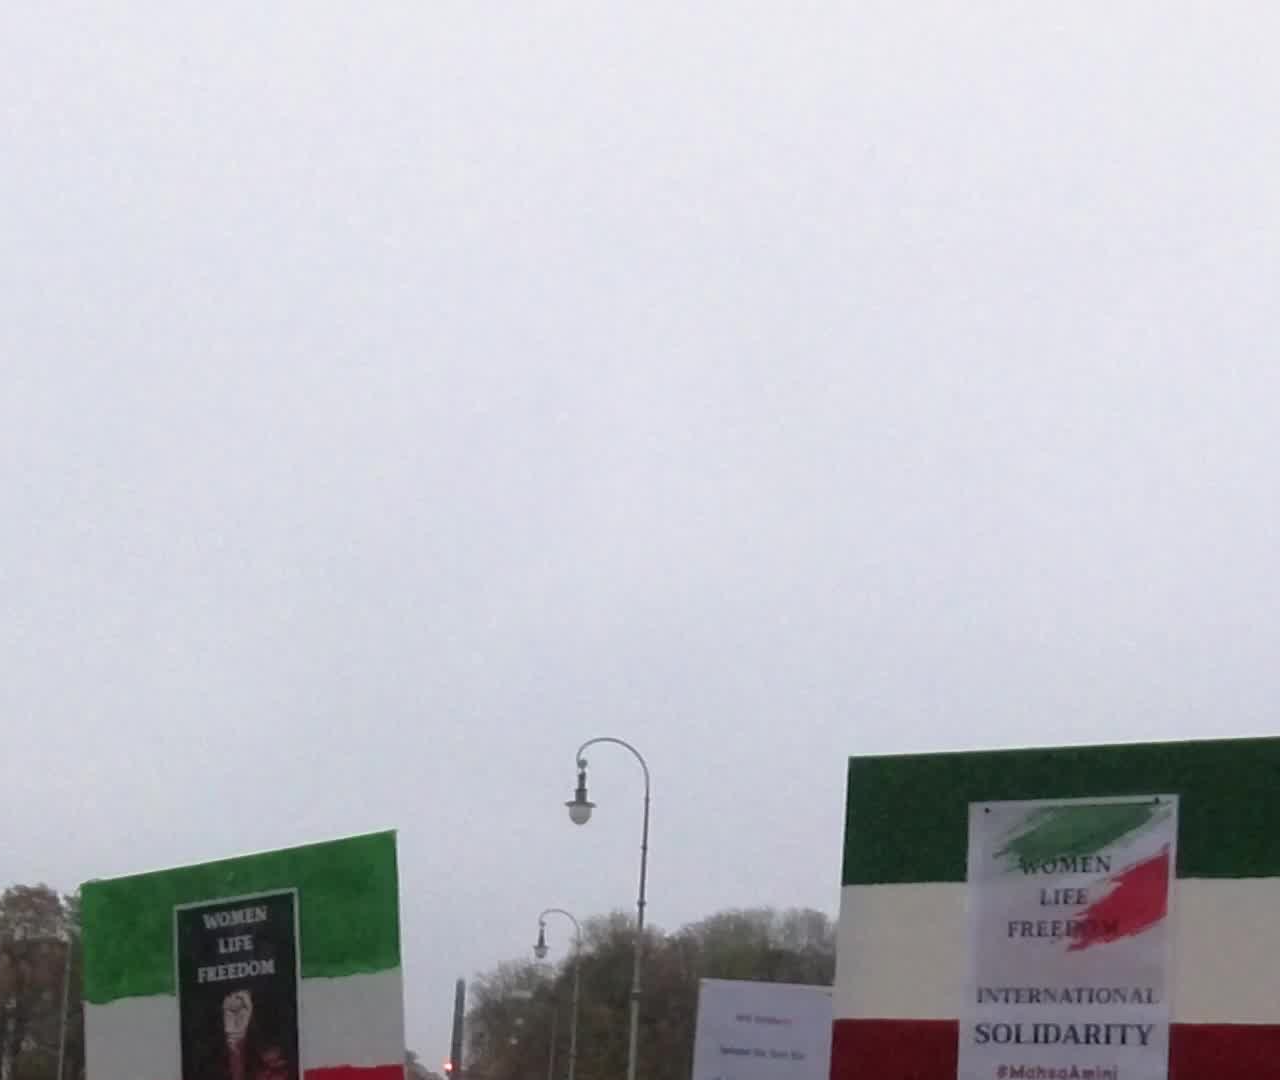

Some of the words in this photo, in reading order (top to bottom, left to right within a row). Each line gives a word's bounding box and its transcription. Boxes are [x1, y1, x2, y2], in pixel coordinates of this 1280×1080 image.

[1020, 854, 1112, 876] WOMEN
[1039, 887, 1089, 907] LIFE
[203, 905, 267, 929] WOMEN
[218, 934, 253, 954] LIFE
[197, 958, 276, 984] FREEDOM
[976, 986, 1160, 1005] INTERNATIONAL
[975, 1022, 1154, 1046] SOLIDARITY
[996, 1063, 1119, 1080] #MahsaAmini
